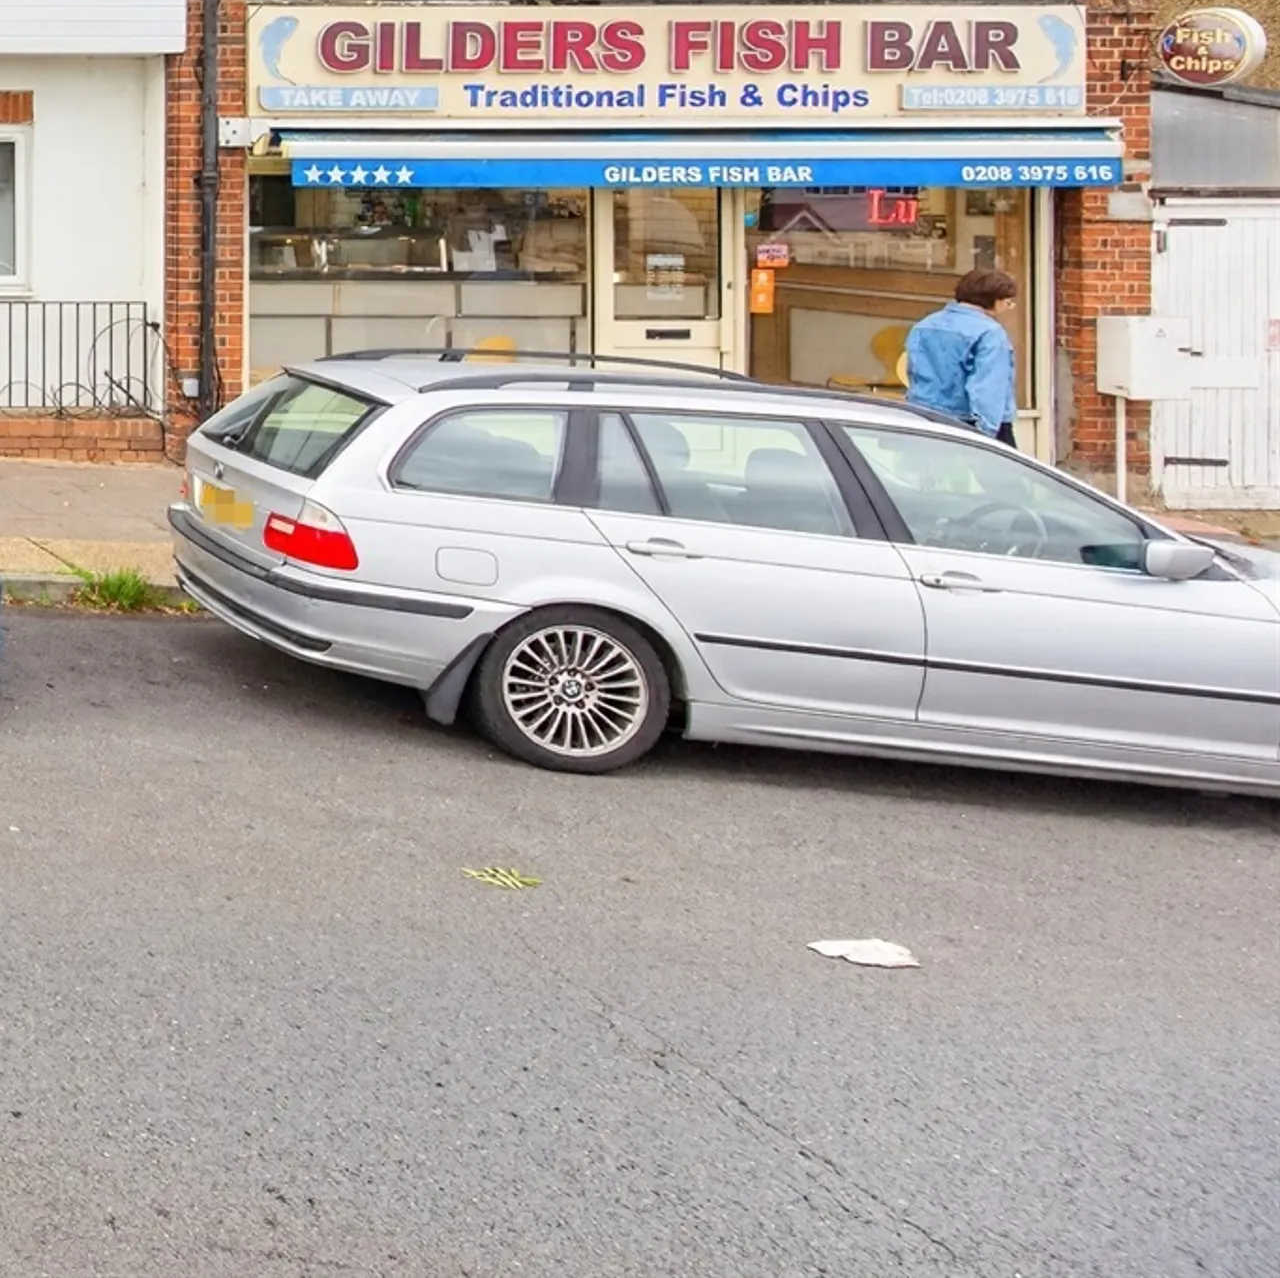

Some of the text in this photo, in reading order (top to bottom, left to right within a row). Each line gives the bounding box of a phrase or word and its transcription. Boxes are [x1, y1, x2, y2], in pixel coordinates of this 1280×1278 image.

[1175, 28, 1231, 44] Fish
[317, 19, 1022, 74] GILDERS FISH BAR
[1197, 45, 1209, 56] &
[1169, 56, 1236, 74] Chips
[280, 89, 419, 107] TAKE AWAY
[463, 83, 870, 113] Traditional Fish & Chips
[995, 87, 1039, 106] 3975
[1044, 87, 1080, 106] 616
[603, 165, 814, 184] GILDERS FISH BAR
[961, 165, 1114, 182] 0208 3975 616
